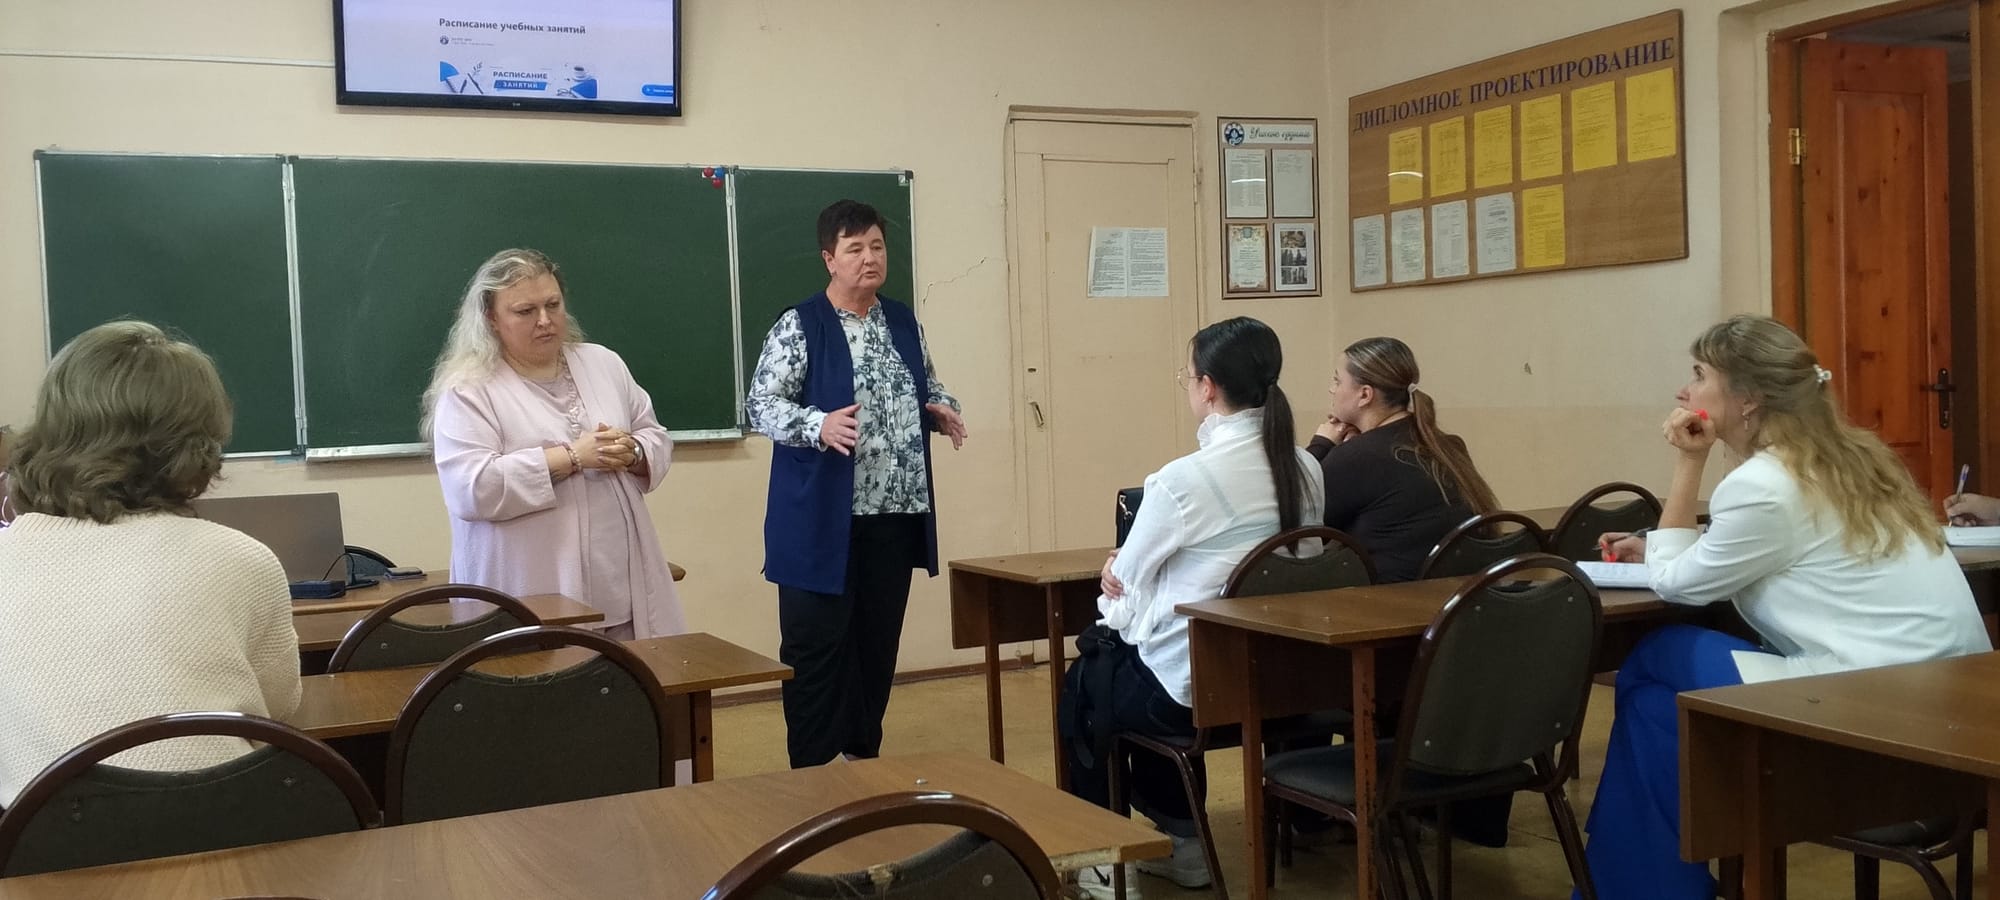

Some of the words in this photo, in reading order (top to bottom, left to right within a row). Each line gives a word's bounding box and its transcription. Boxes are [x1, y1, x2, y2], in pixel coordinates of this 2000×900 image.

[439, 18, 498, 29] Расписание
[500, 21, 544, 32] учебных
[546, 25, 586, 34] занятий
[492, 71, 548, 80] РАСПИСАНИЕ
[1353, 88, 1463, 134] ДИПЛОМНОЕ
[1470, 38, 1675, 104] ПРОЕКТИРОВАНИЕ
